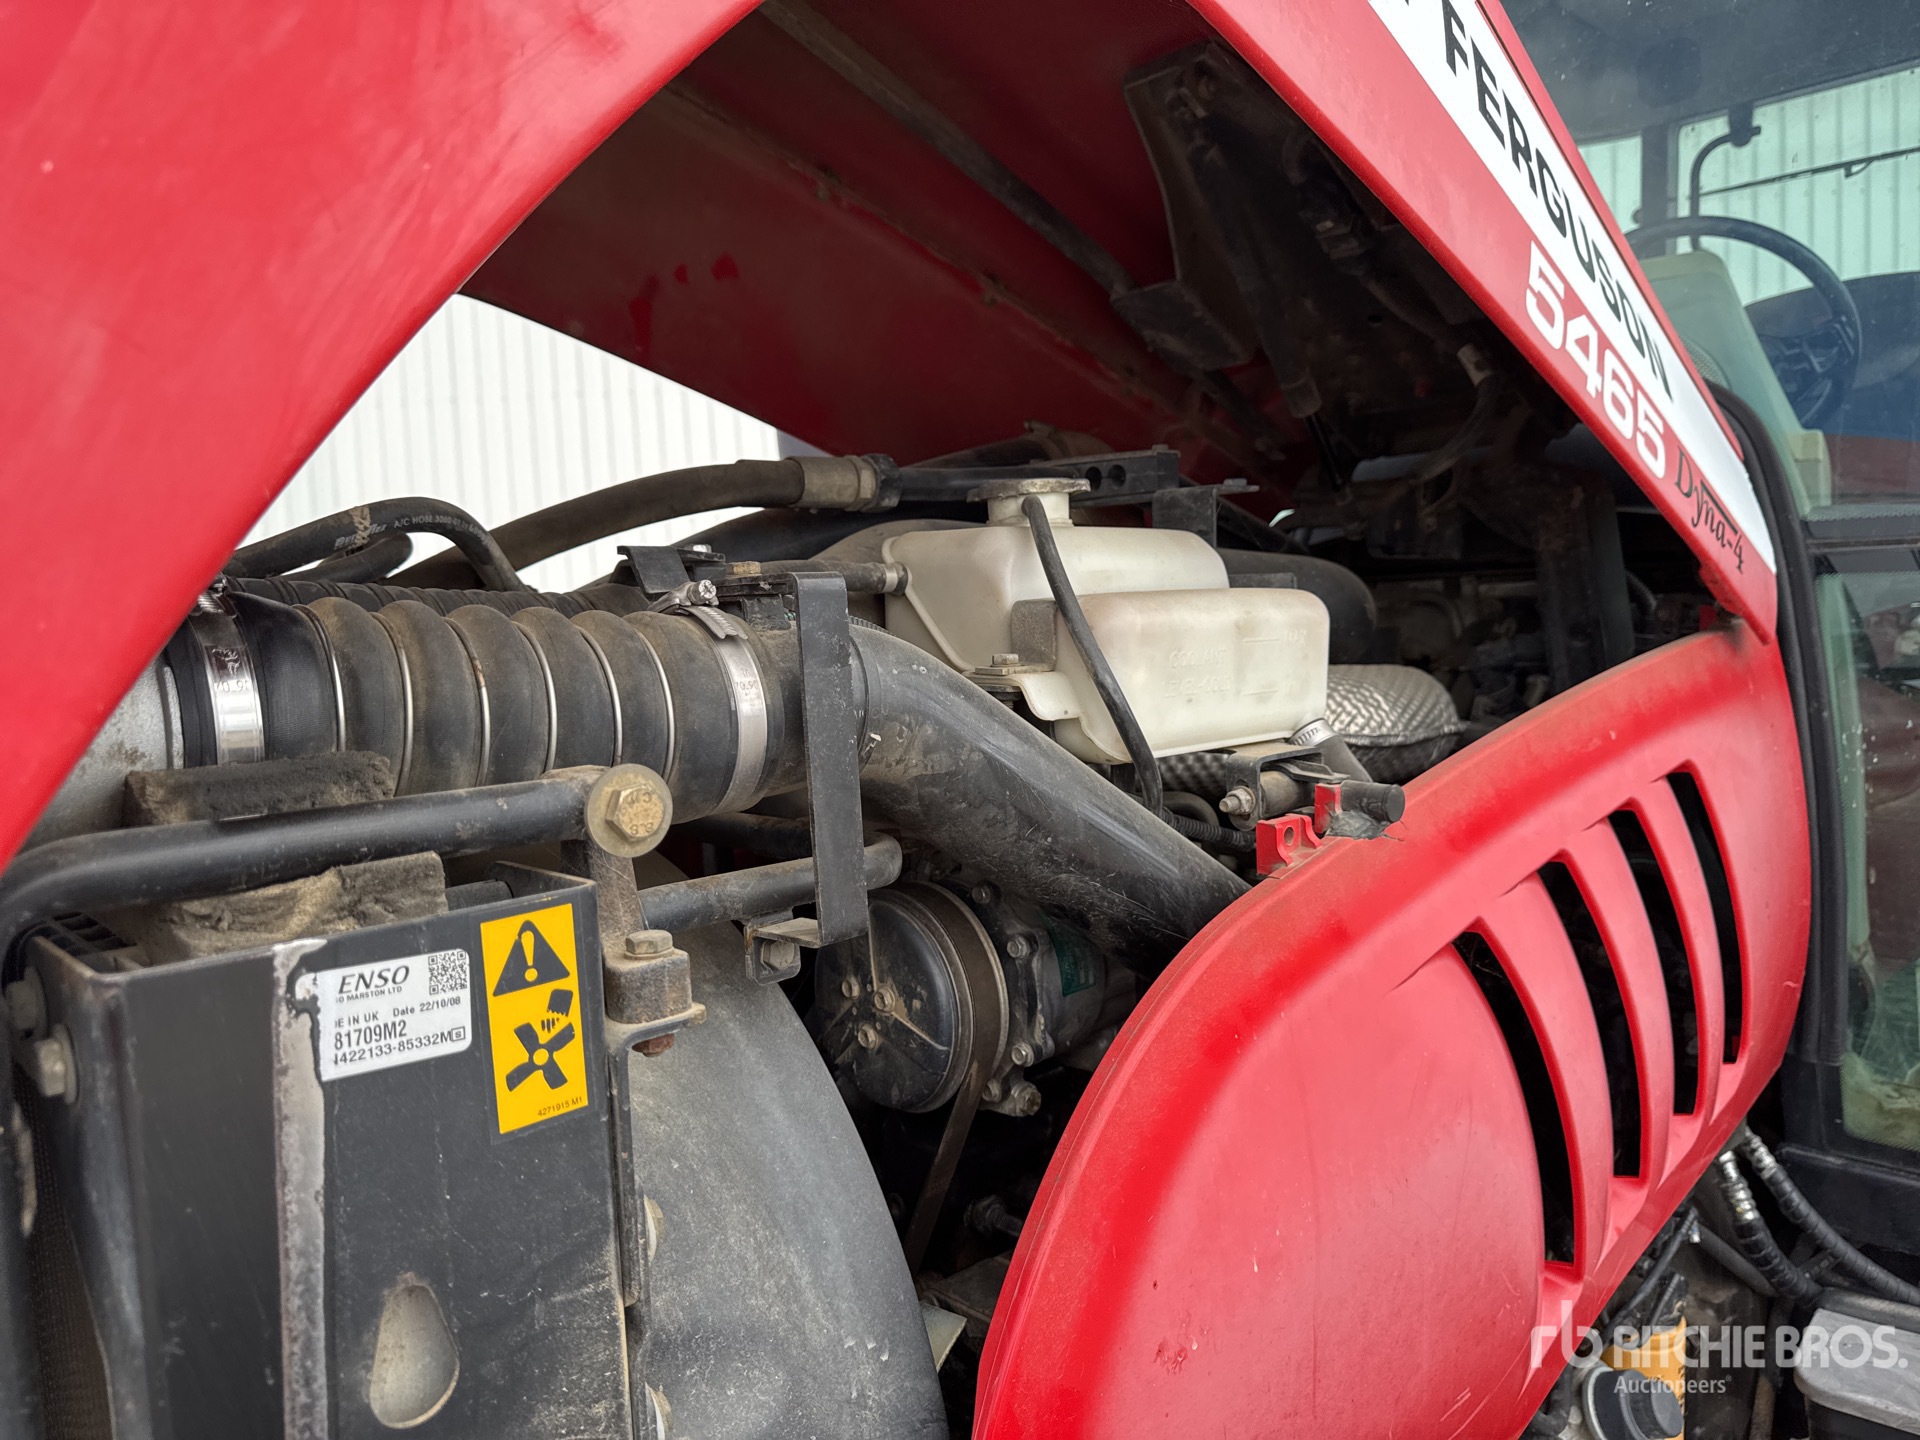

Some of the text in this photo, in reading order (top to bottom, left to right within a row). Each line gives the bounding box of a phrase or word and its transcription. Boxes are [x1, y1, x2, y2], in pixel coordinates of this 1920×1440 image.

[1442, 0, 1674, 404] FERGUSON
[1525, 239, 1666, 480] 5465
[393, 517, 411, 529] A/C
[412, 514, 433, 525] HOSE
[1674, 444, 1745, 575] Dyna-4
[337, 964, 411, 995] ENSO
[346, 988, 386, 1003] MARSTON
[387, 985, 403, 995] LTD
[347, 1014, 360, 1026] IN
[363, 1010, 380, 1023] UK
[392, 1006, 416, 1018] Date
[419, 995, 462, 1013] 22/10/08
[334, 1019, 408, 1051] 81709M2
[536, 1095, 584, 1118] 4271915 M1
